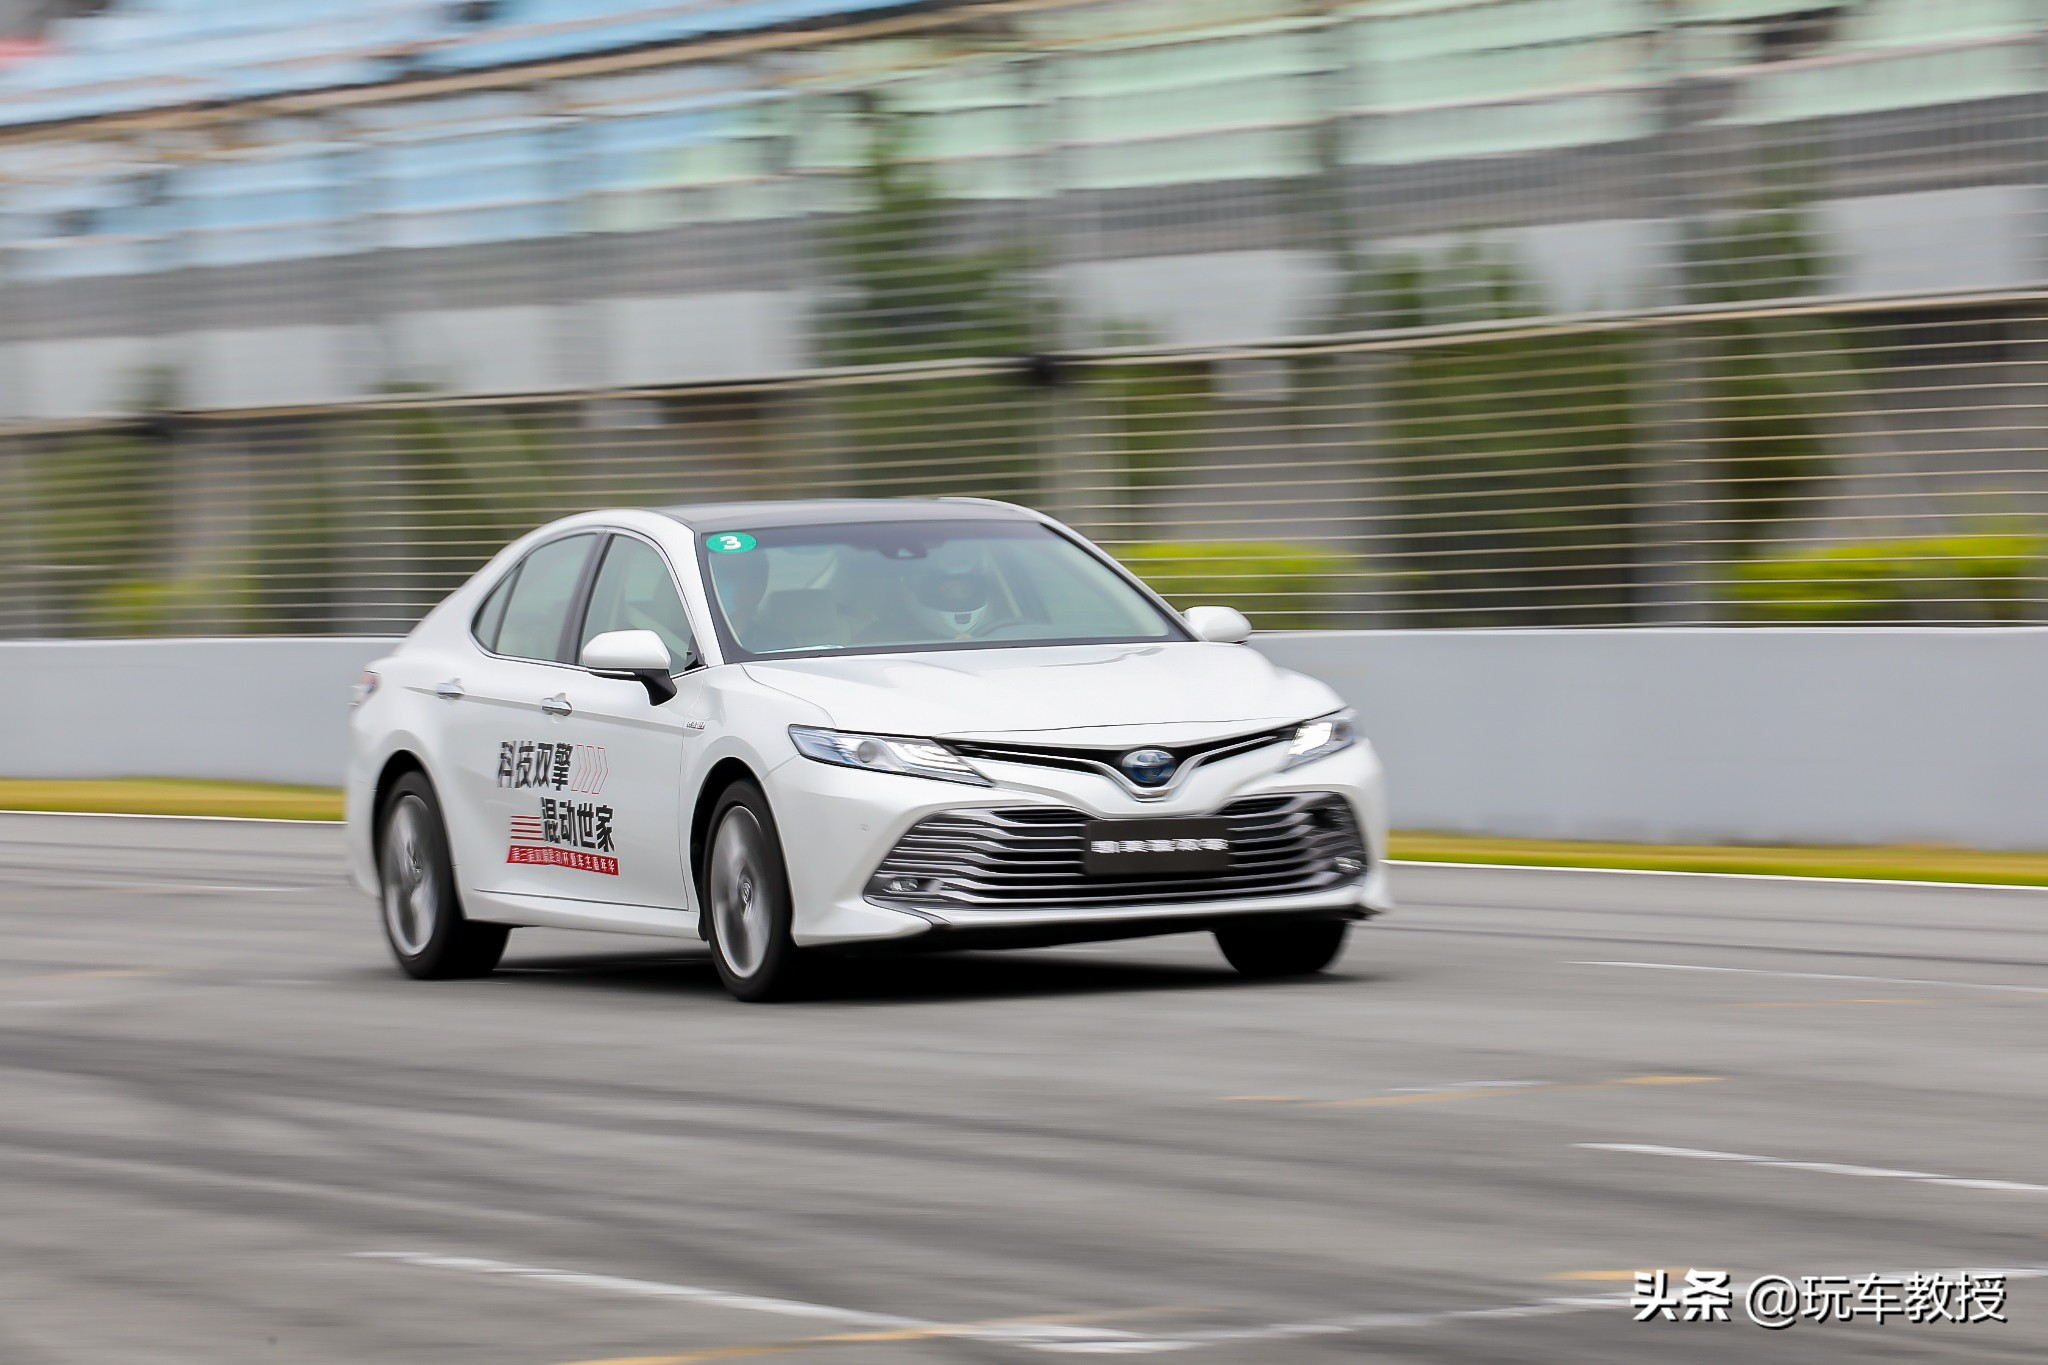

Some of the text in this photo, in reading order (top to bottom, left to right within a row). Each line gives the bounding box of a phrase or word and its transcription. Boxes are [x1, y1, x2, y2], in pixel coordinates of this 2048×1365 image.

[719, 535, 742, 550] 3
[497, 740, 574, 792] 科技双擎
[540, 796, 615, 852] 混动世家
